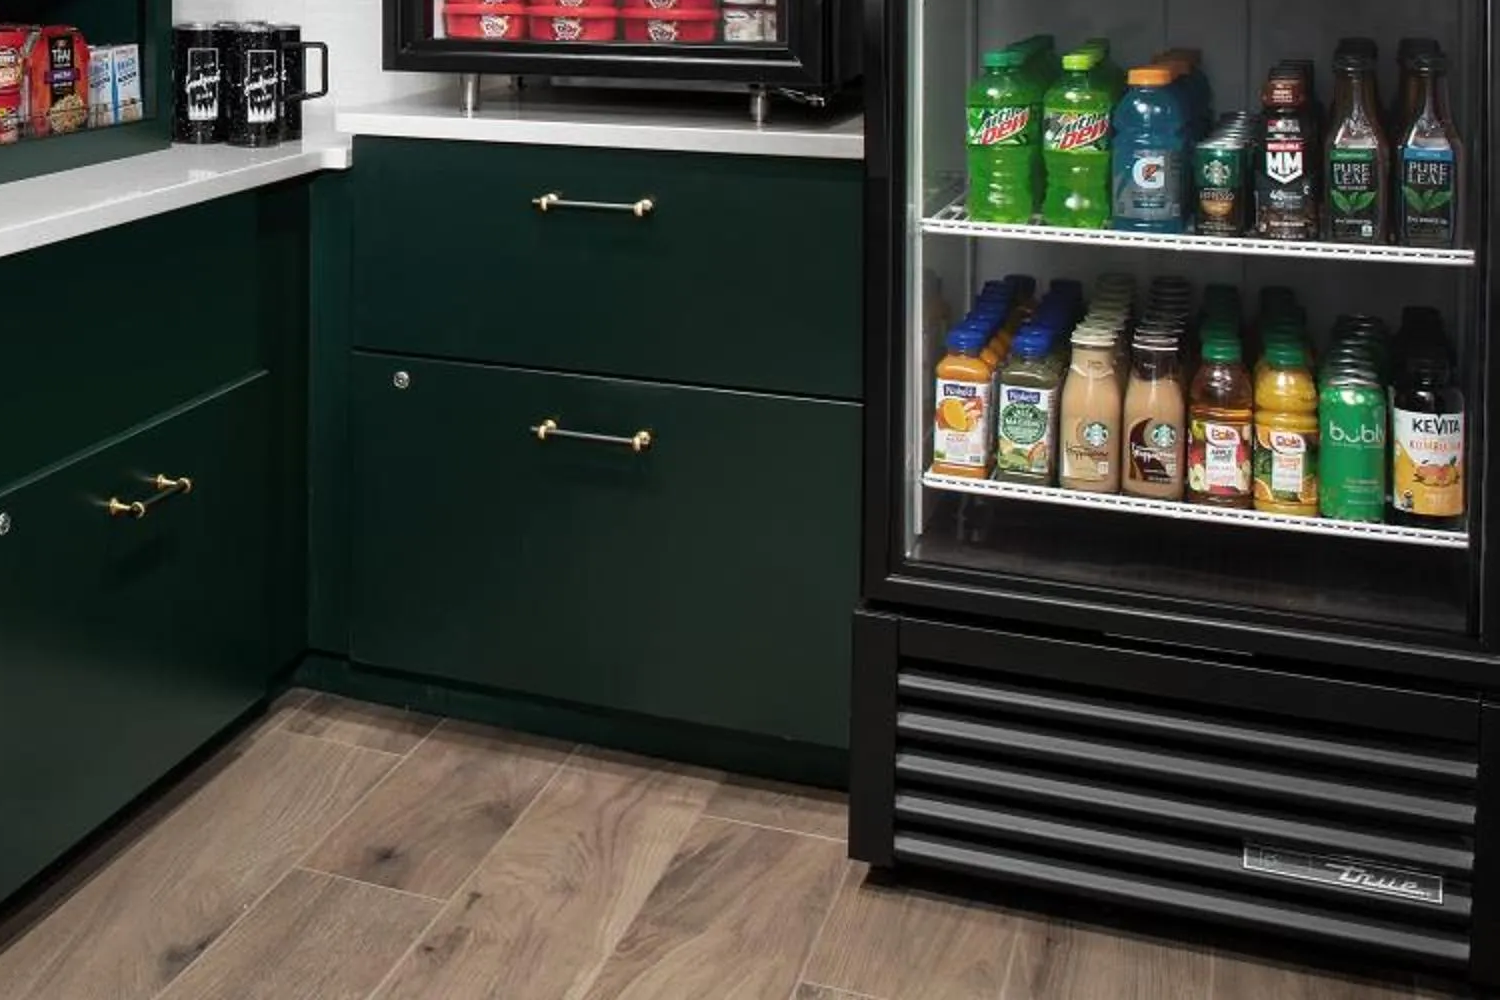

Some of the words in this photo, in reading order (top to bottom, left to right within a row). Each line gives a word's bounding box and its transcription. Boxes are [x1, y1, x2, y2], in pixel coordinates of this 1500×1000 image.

[1132, 156, 1166, 189] G
[1333, 163, 1371, 173] PURE
[1408, 161, 1449, 173] PURE
[1334, 172, 1371, 185] LEAF
[1408, 172, 1448, 185] LEAF
[1411, 418, 1461, 436] KEVITA
